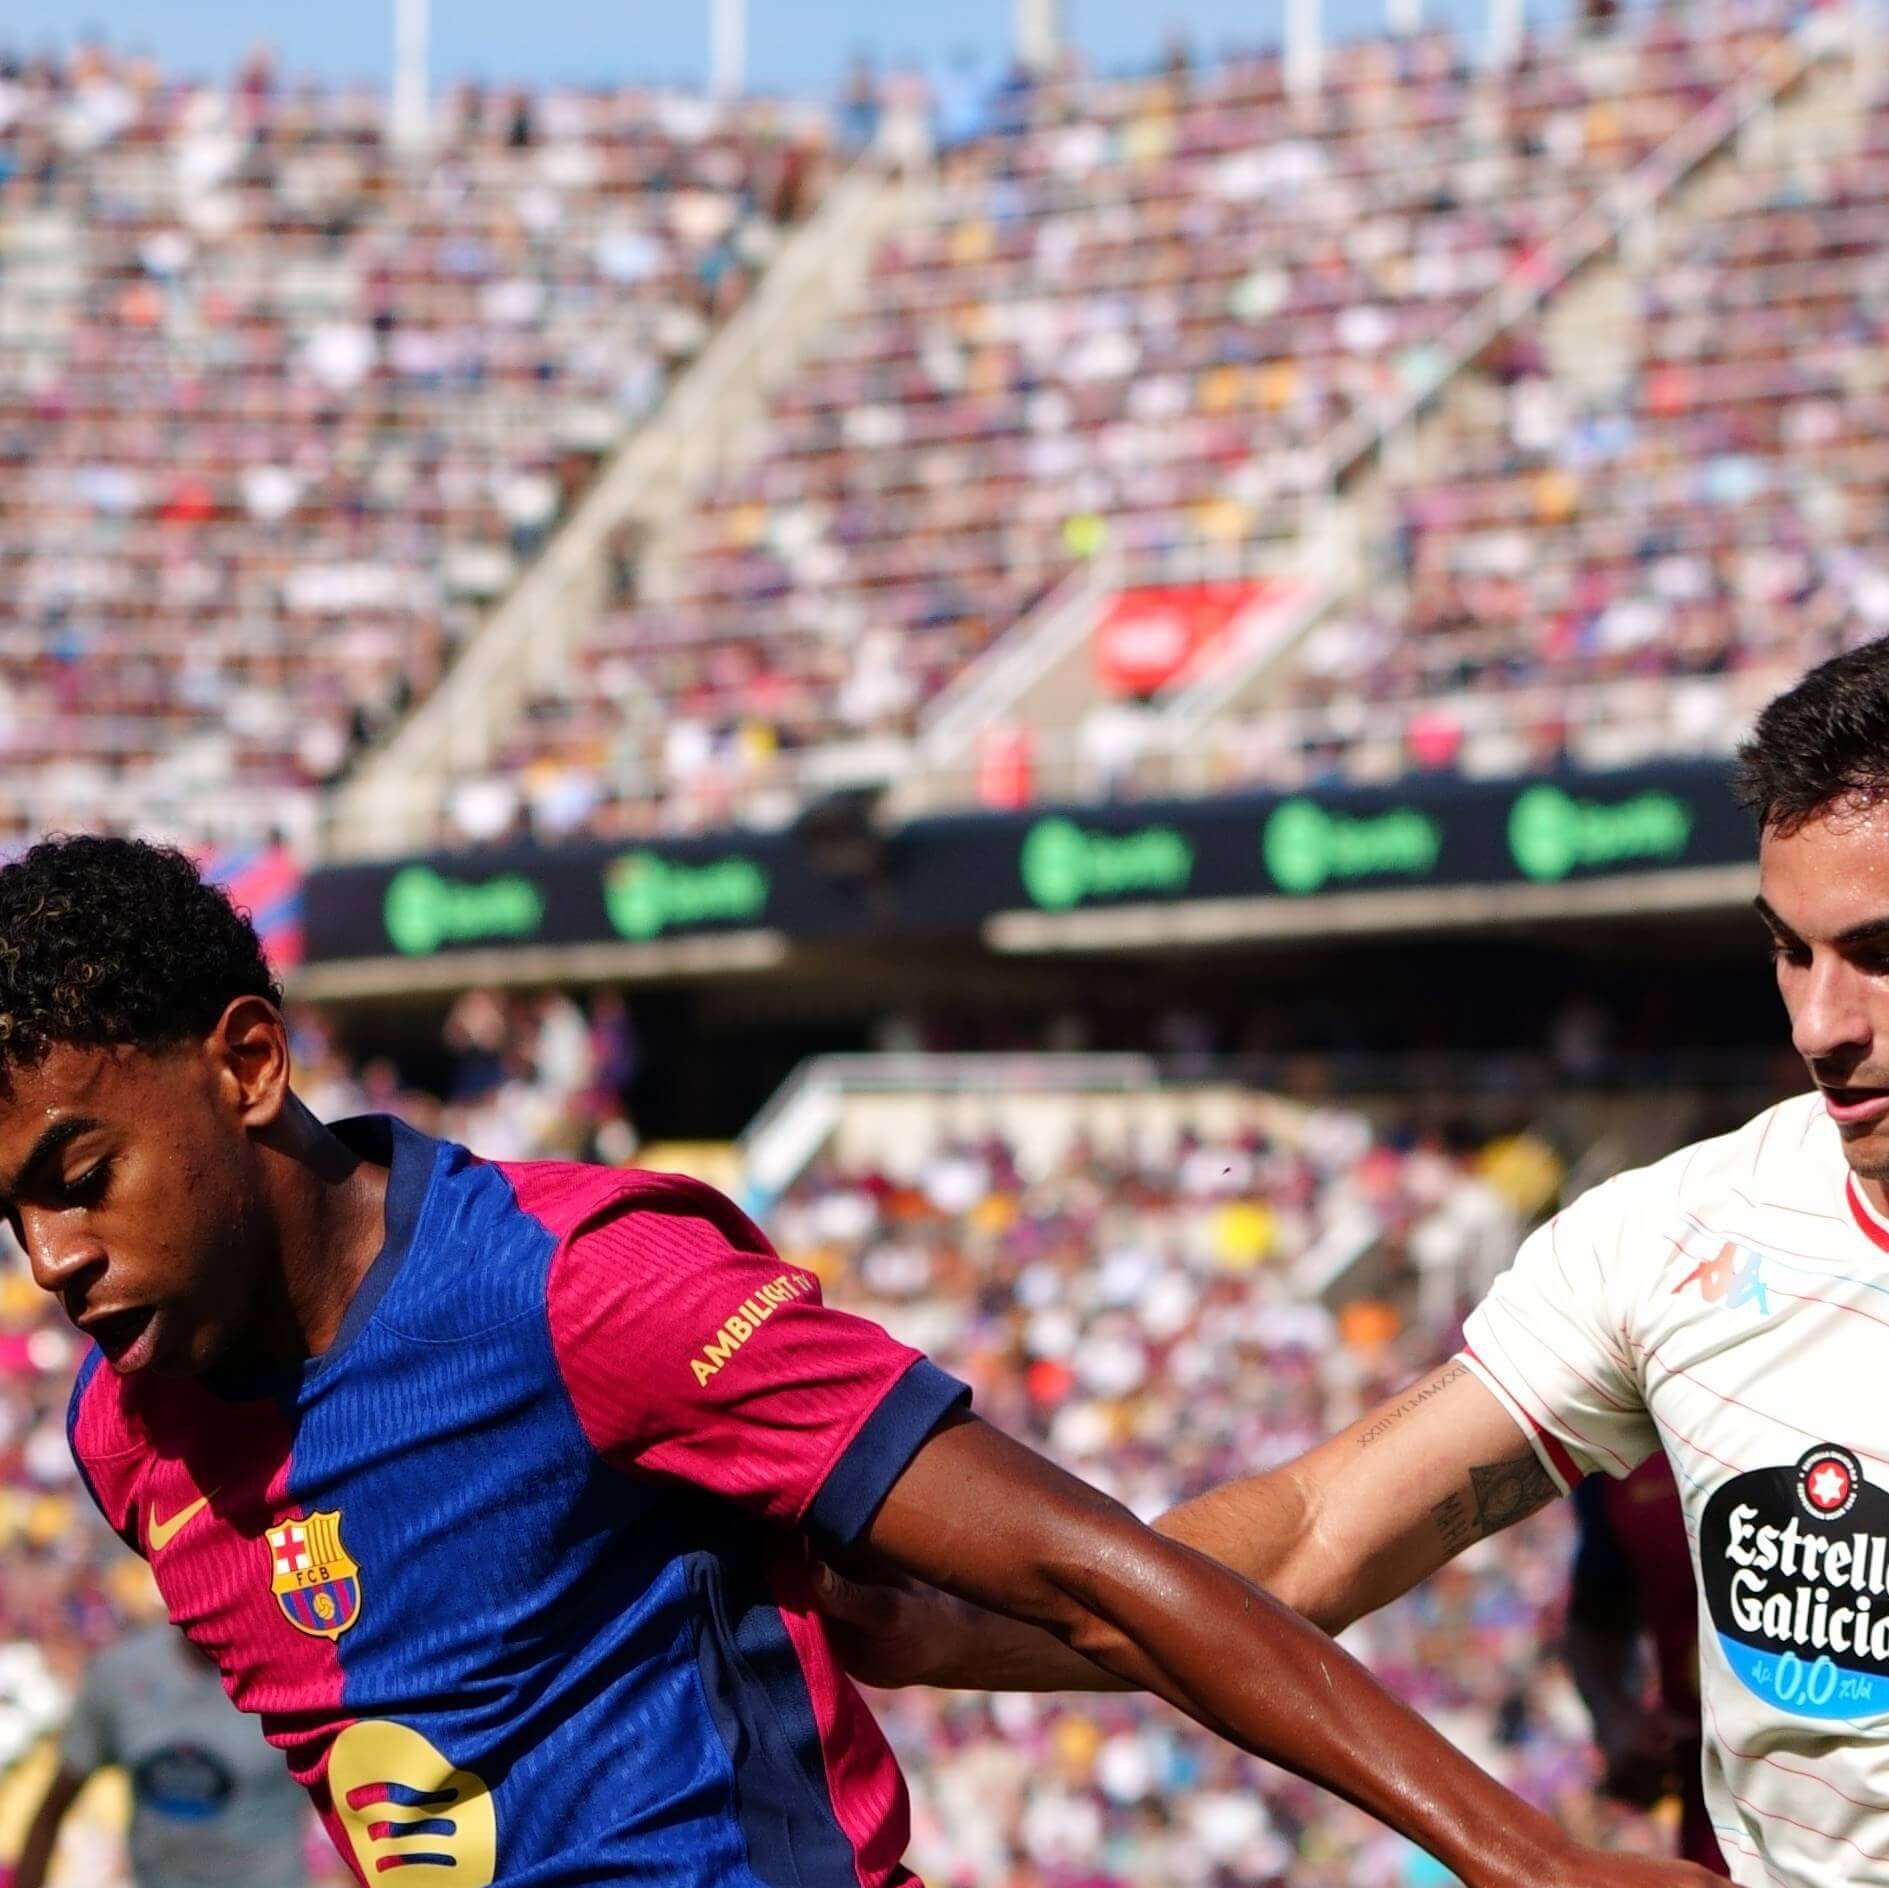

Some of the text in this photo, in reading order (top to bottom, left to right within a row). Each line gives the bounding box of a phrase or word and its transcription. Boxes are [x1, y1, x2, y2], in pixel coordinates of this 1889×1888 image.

[690, 1275, 801, 1388] AMBILIGHT
[295, 1566, 330, 1587] FCB
[1774, 1650, 1838, 1706] 0,0
